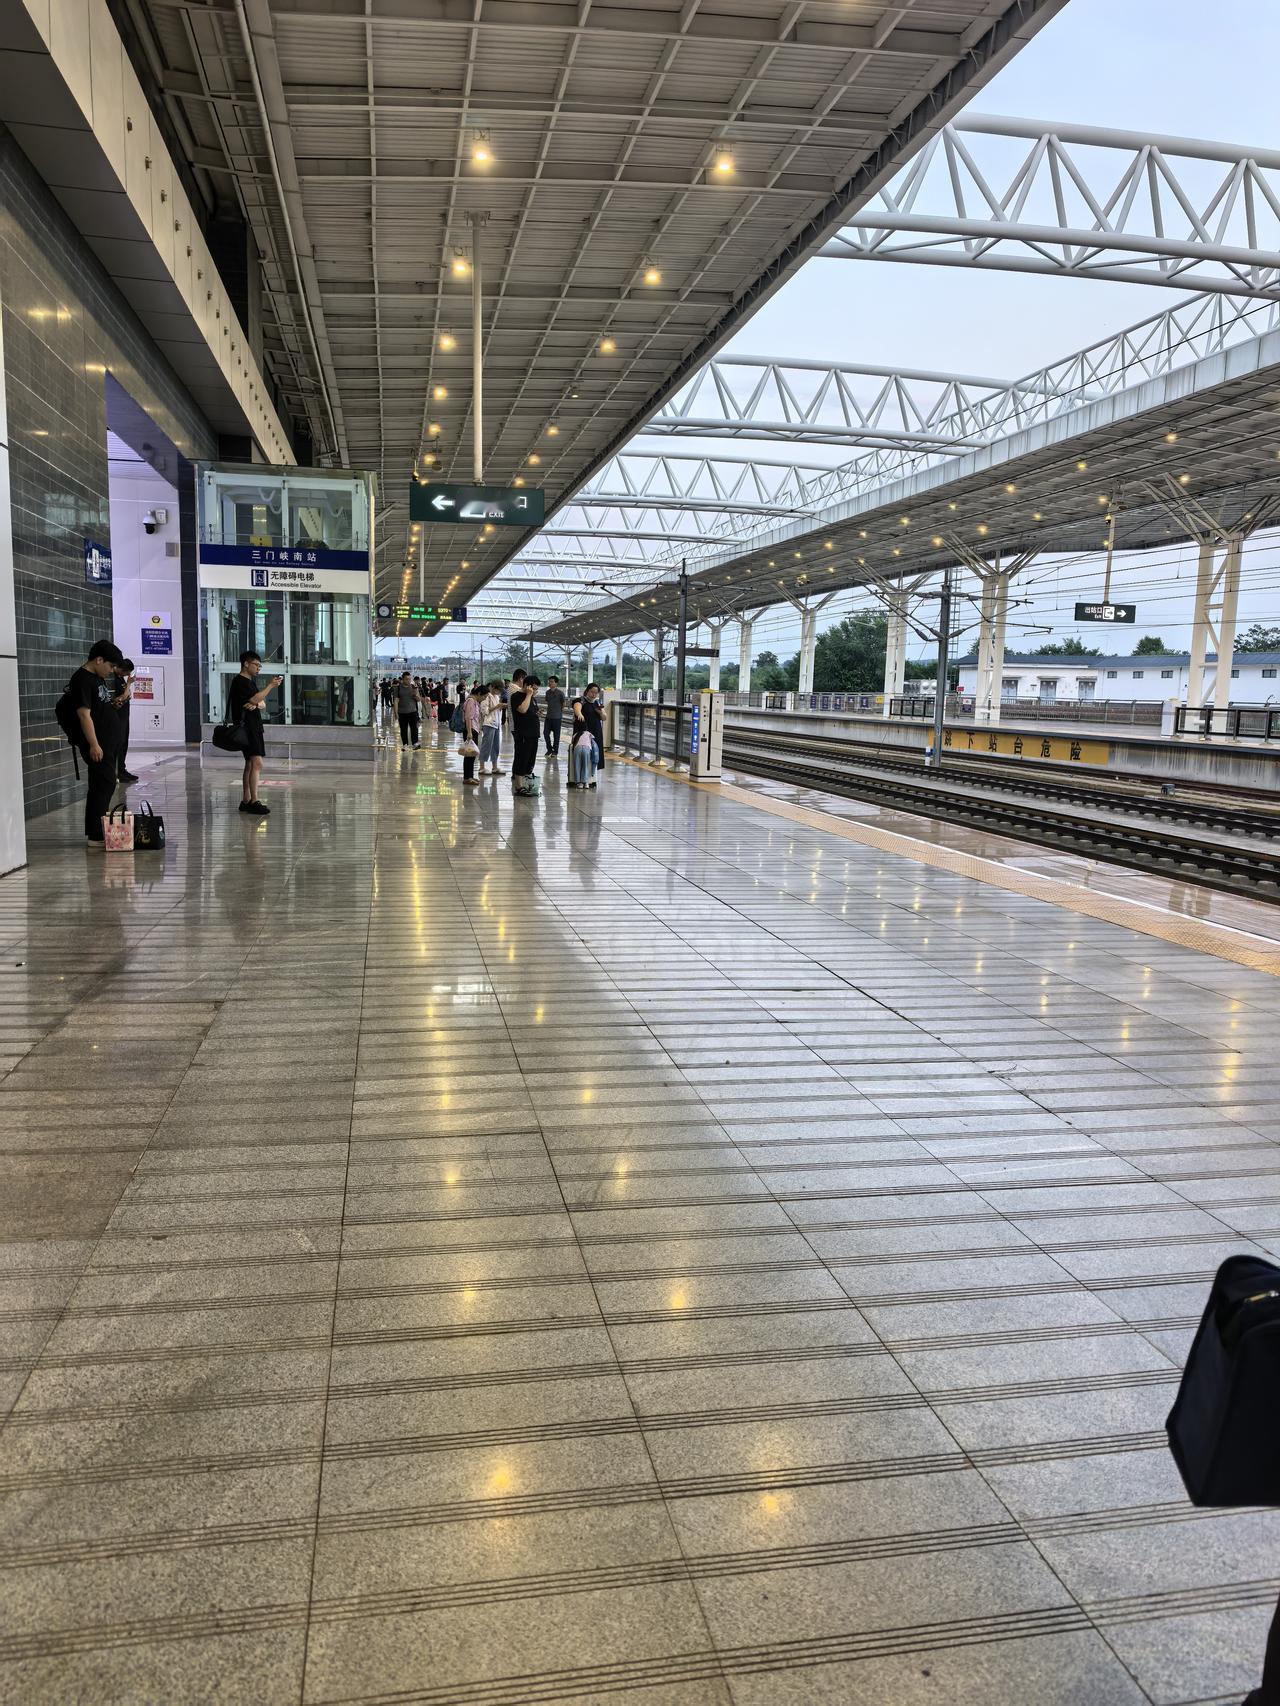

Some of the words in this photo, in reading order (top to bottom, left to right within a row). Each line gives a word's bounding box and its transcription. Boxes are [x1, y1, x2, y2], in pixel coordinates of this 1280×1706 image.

[251, 550, 317, 562] 三门峡南站
[270, 571, 315, 581] 无障碍电梯
[1084, 606, 1103, 614] 出站口
